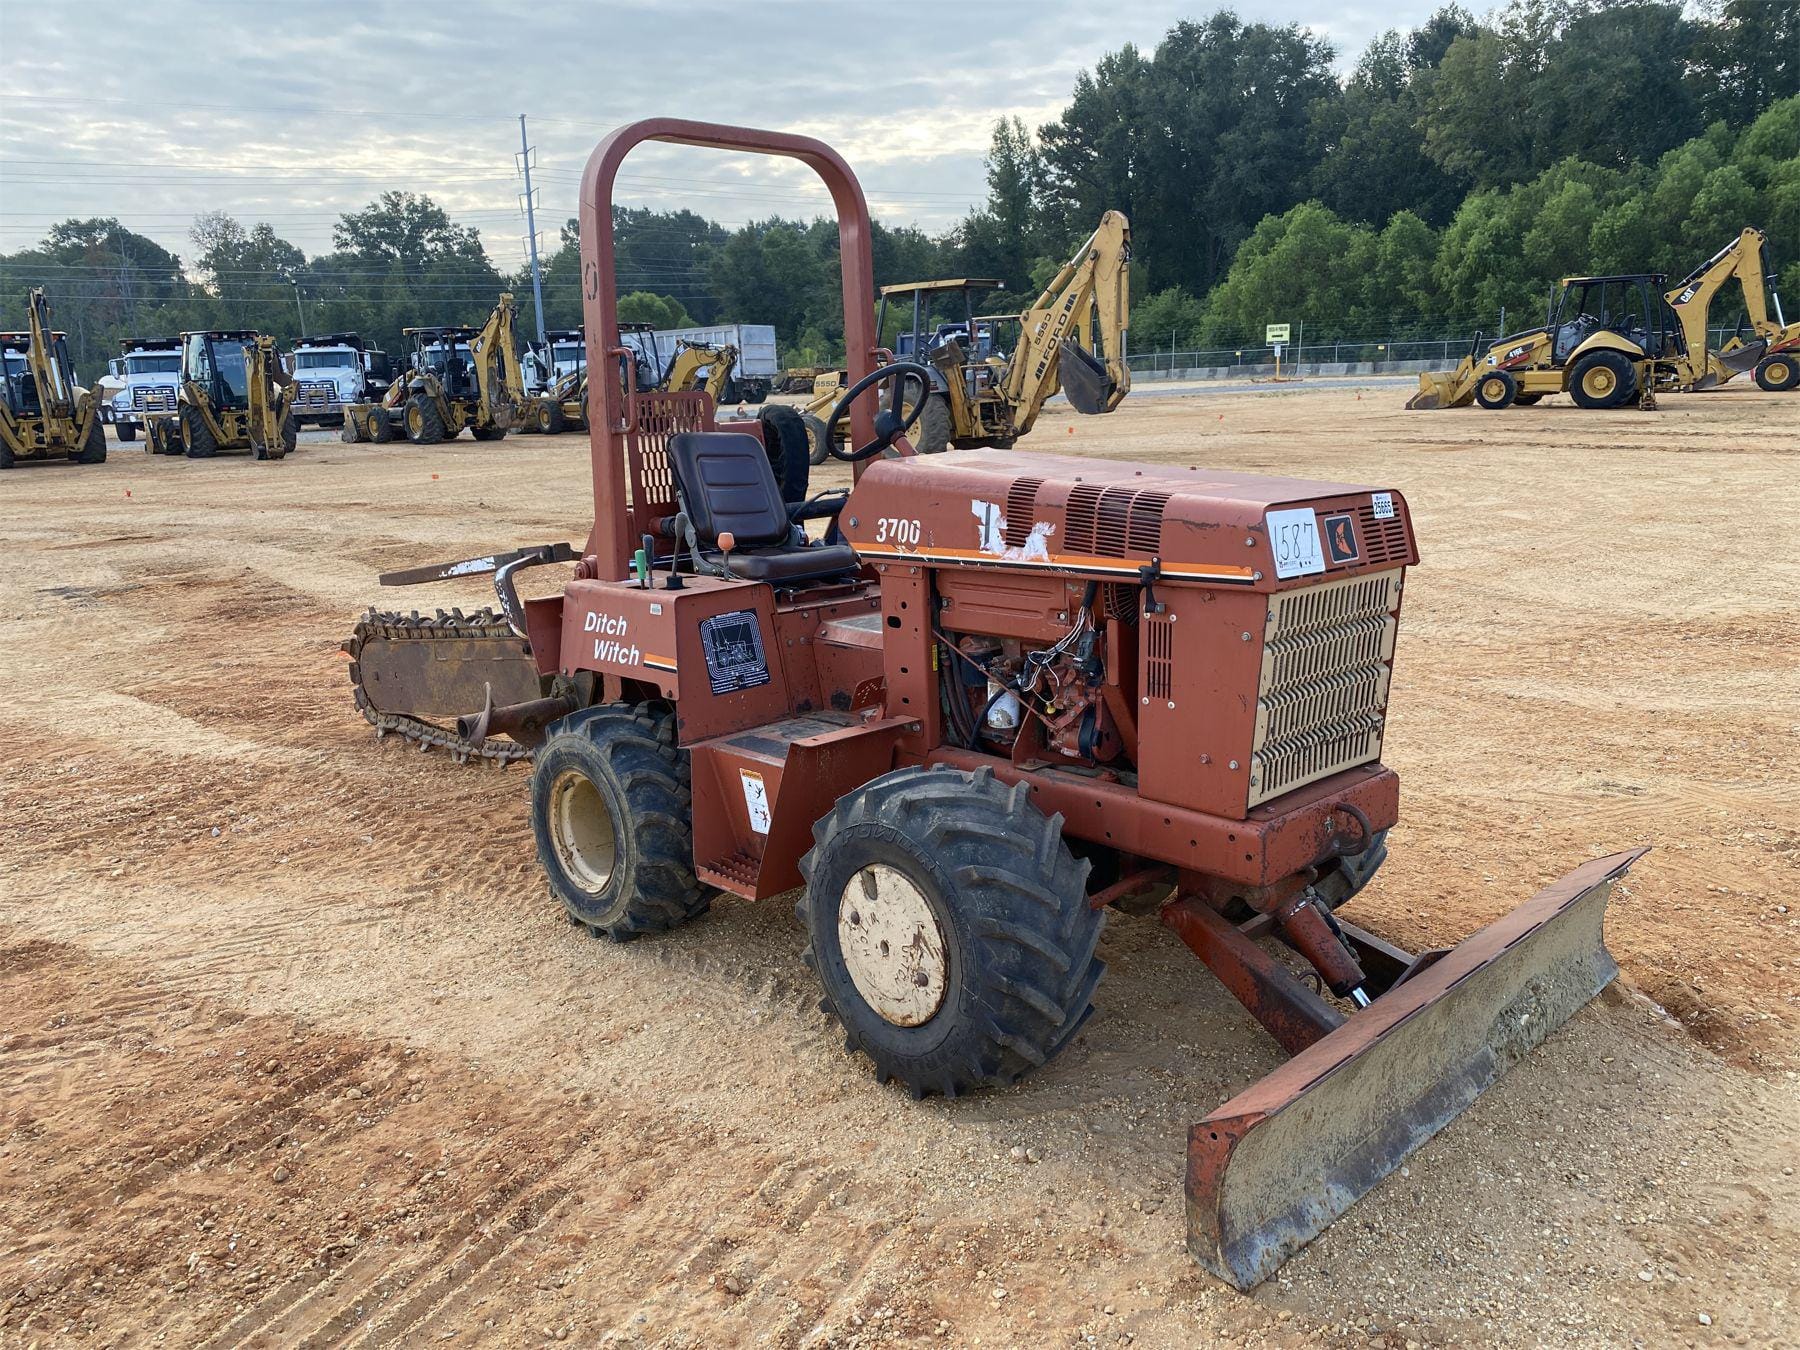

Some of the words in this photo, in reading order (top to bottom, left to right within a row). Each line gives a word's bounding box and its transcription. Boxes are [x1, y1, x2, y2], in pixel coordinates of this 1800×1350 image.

[1680, 287, 1695, 303] CAT
[1034, 312, 1051, 346] 555D
[1043, 313, 1067, 361] FORD
[876, 517, 921, 544] 3700
[1274, 523, 1314, 561] 1587
[584, 611, 628, 636] Ditch
[593, 638, 640, 666] Witch
